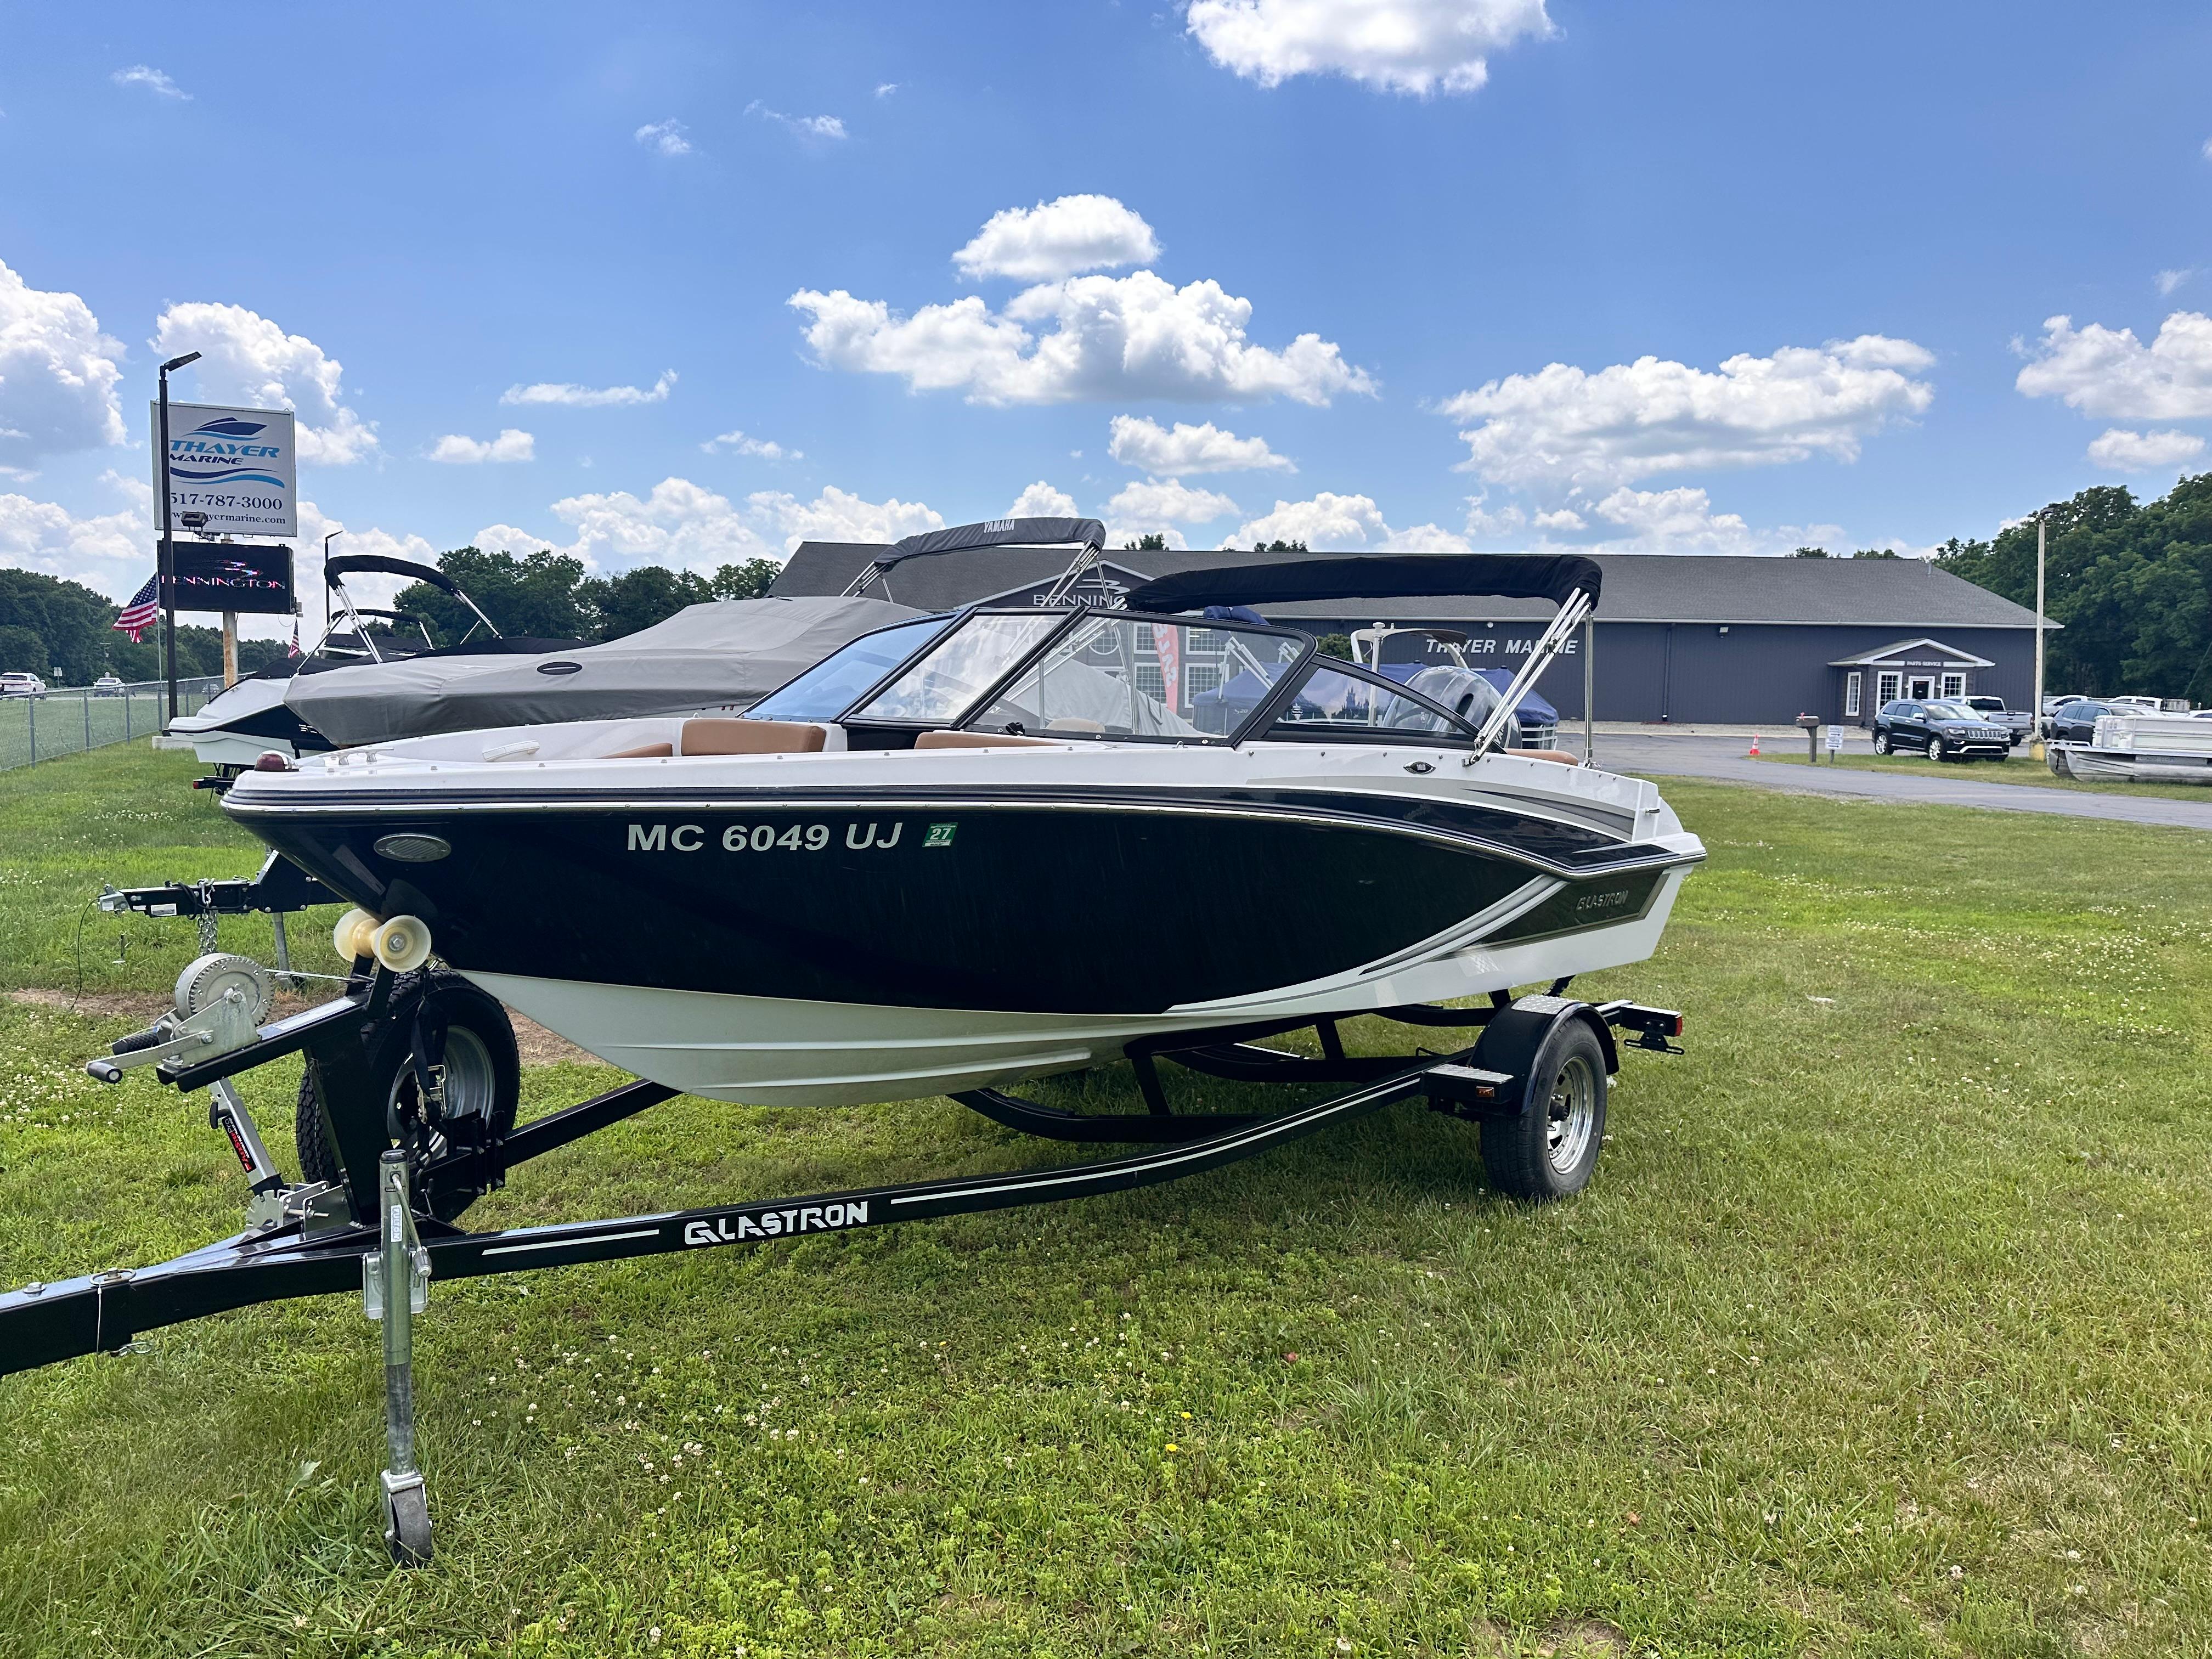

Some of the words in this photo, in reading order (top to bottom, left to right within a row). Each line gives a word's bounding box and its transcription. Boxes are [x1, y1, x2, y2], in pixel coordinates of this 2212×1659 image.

[170, 440, 280, 458] THAYER
[170, 454, 244, 465] MARINE
[171, 493, 283, 510] 517-787-3000
[984, 519, 1015, 533] YAMAHA
[1505, 640, 1578, 654] MAE
[627, 824, 704, 851] MC
[722, 824, 830, 851] 6049
[845, 822, 903, 850] UJ
[929, 828, 952, 840] 27
[1576, 890, 1629, 911] GLASTRON
[392, 1206, 401, 1240] FULTON
[685, 1201, 868, 1245] GLASTRON
